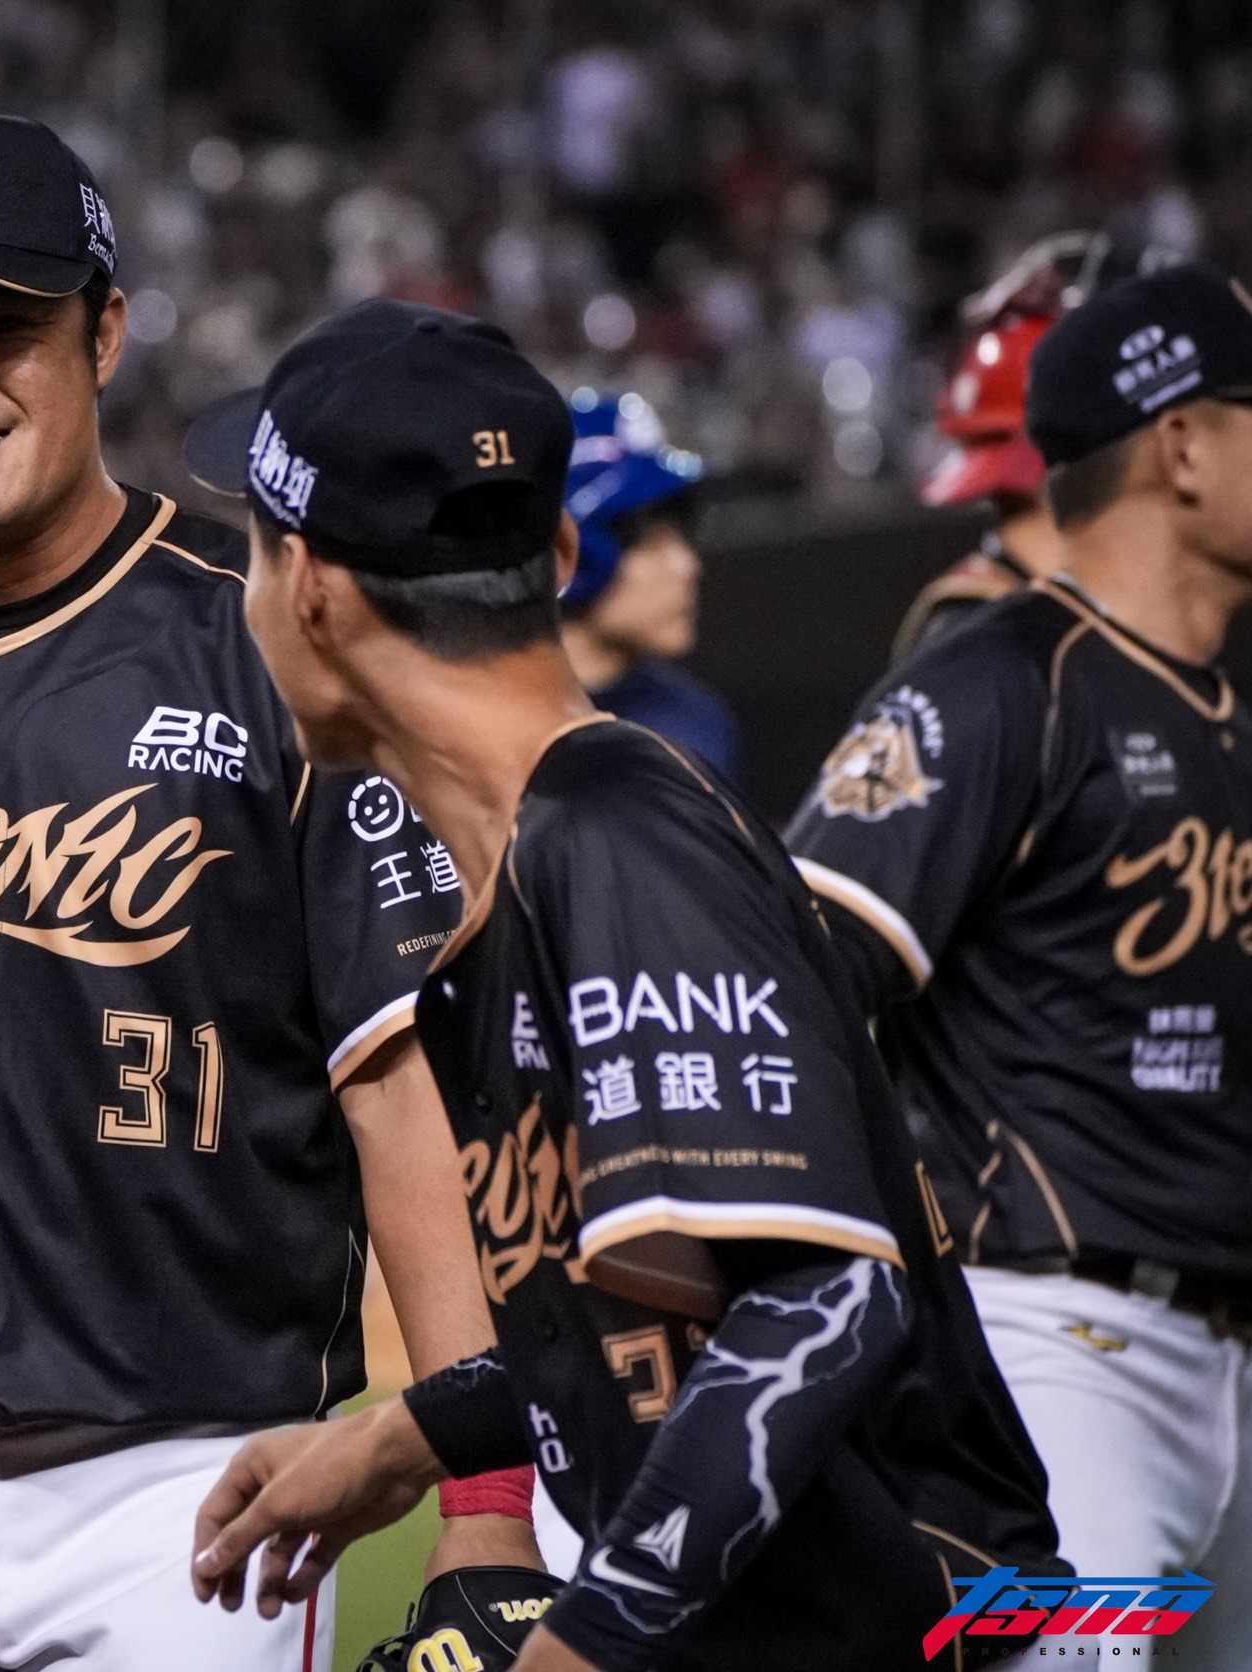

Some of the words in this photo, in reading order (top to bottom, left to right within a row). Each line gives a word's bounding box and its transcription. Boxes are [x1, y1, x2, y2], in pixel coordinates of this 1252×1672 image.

[472, 430, 516, 468] 31
[132, 705, 248, 758] BC
[128, 744, 244, 783] RACING
[569, 970, 790, 1048] BANK
[97, 1008, 224, 1153] 31
